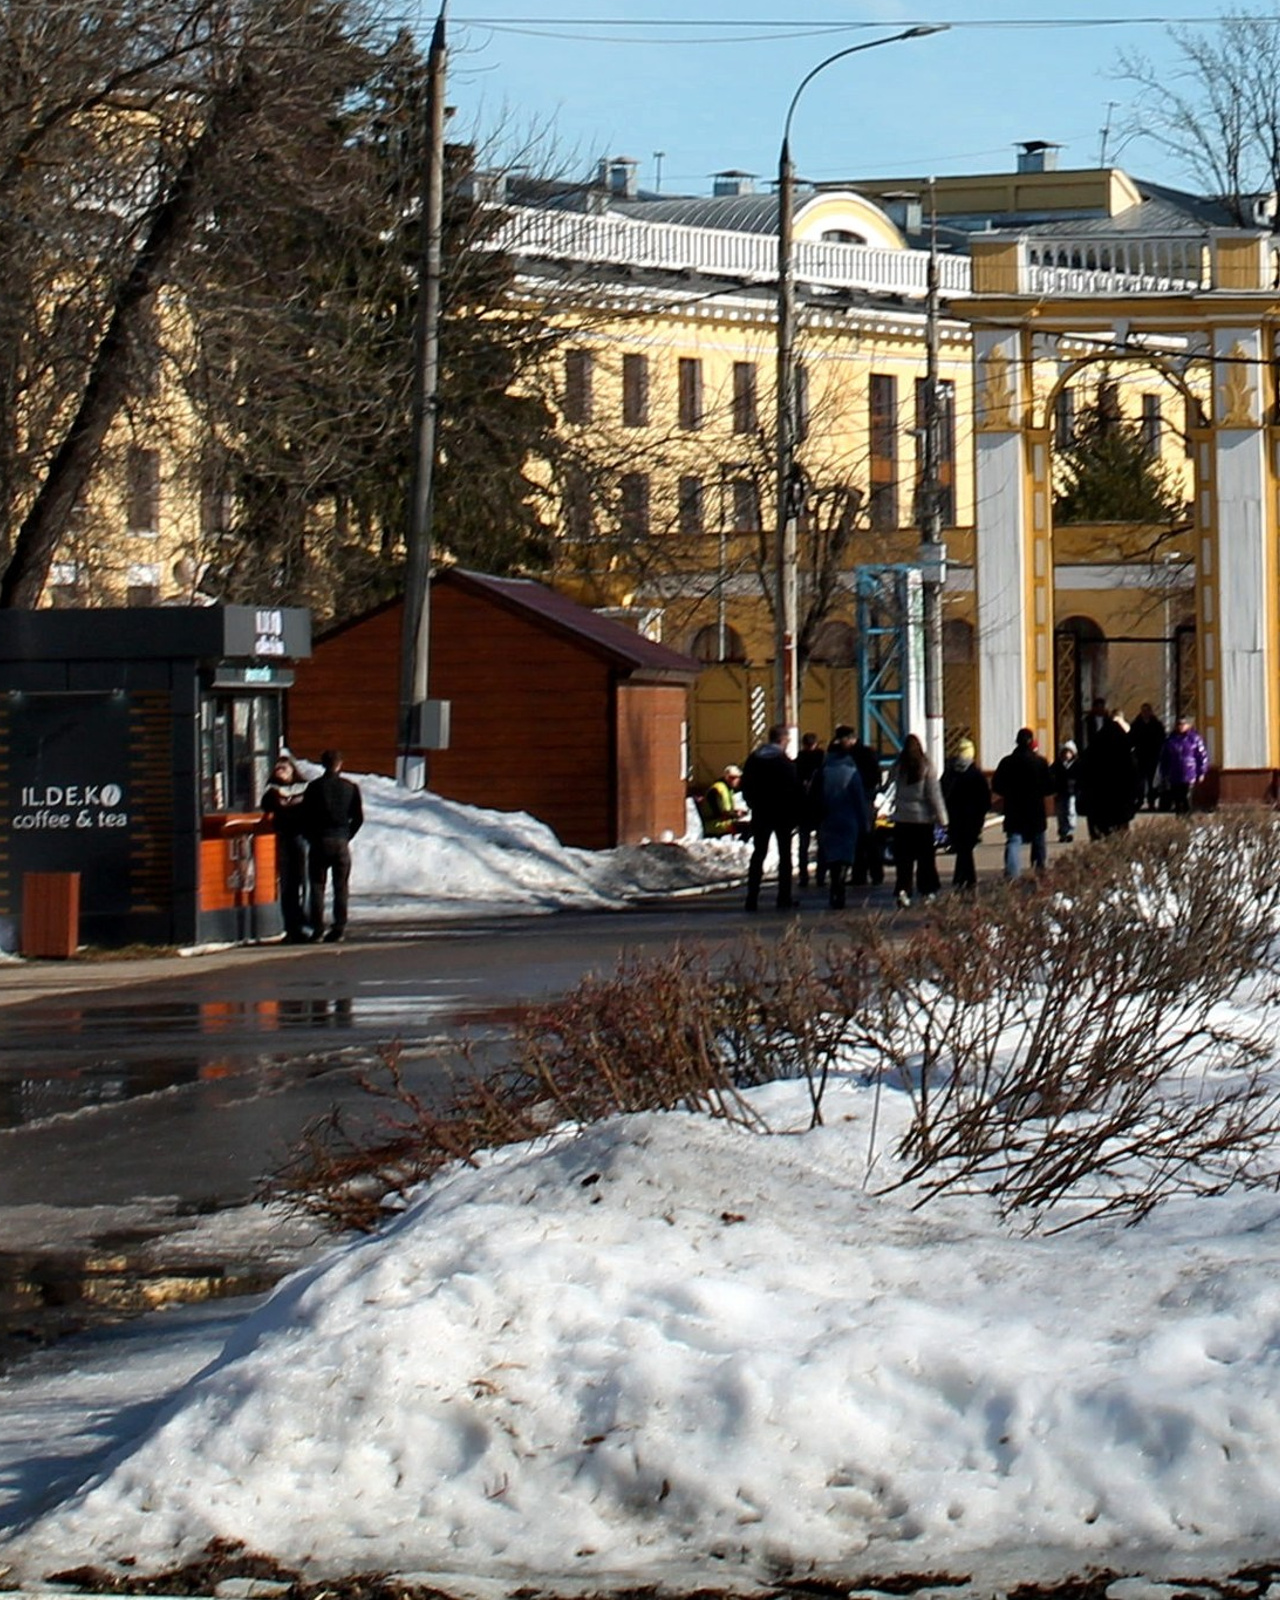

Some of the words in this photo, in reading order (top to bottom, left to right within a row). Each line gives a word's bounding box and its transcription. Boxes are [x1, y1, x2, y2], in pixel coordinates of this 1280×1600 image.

[12, 810, 71, 829] coffee
[76, 809, 93, 828] &
[98, 811, 127, 828] tea
